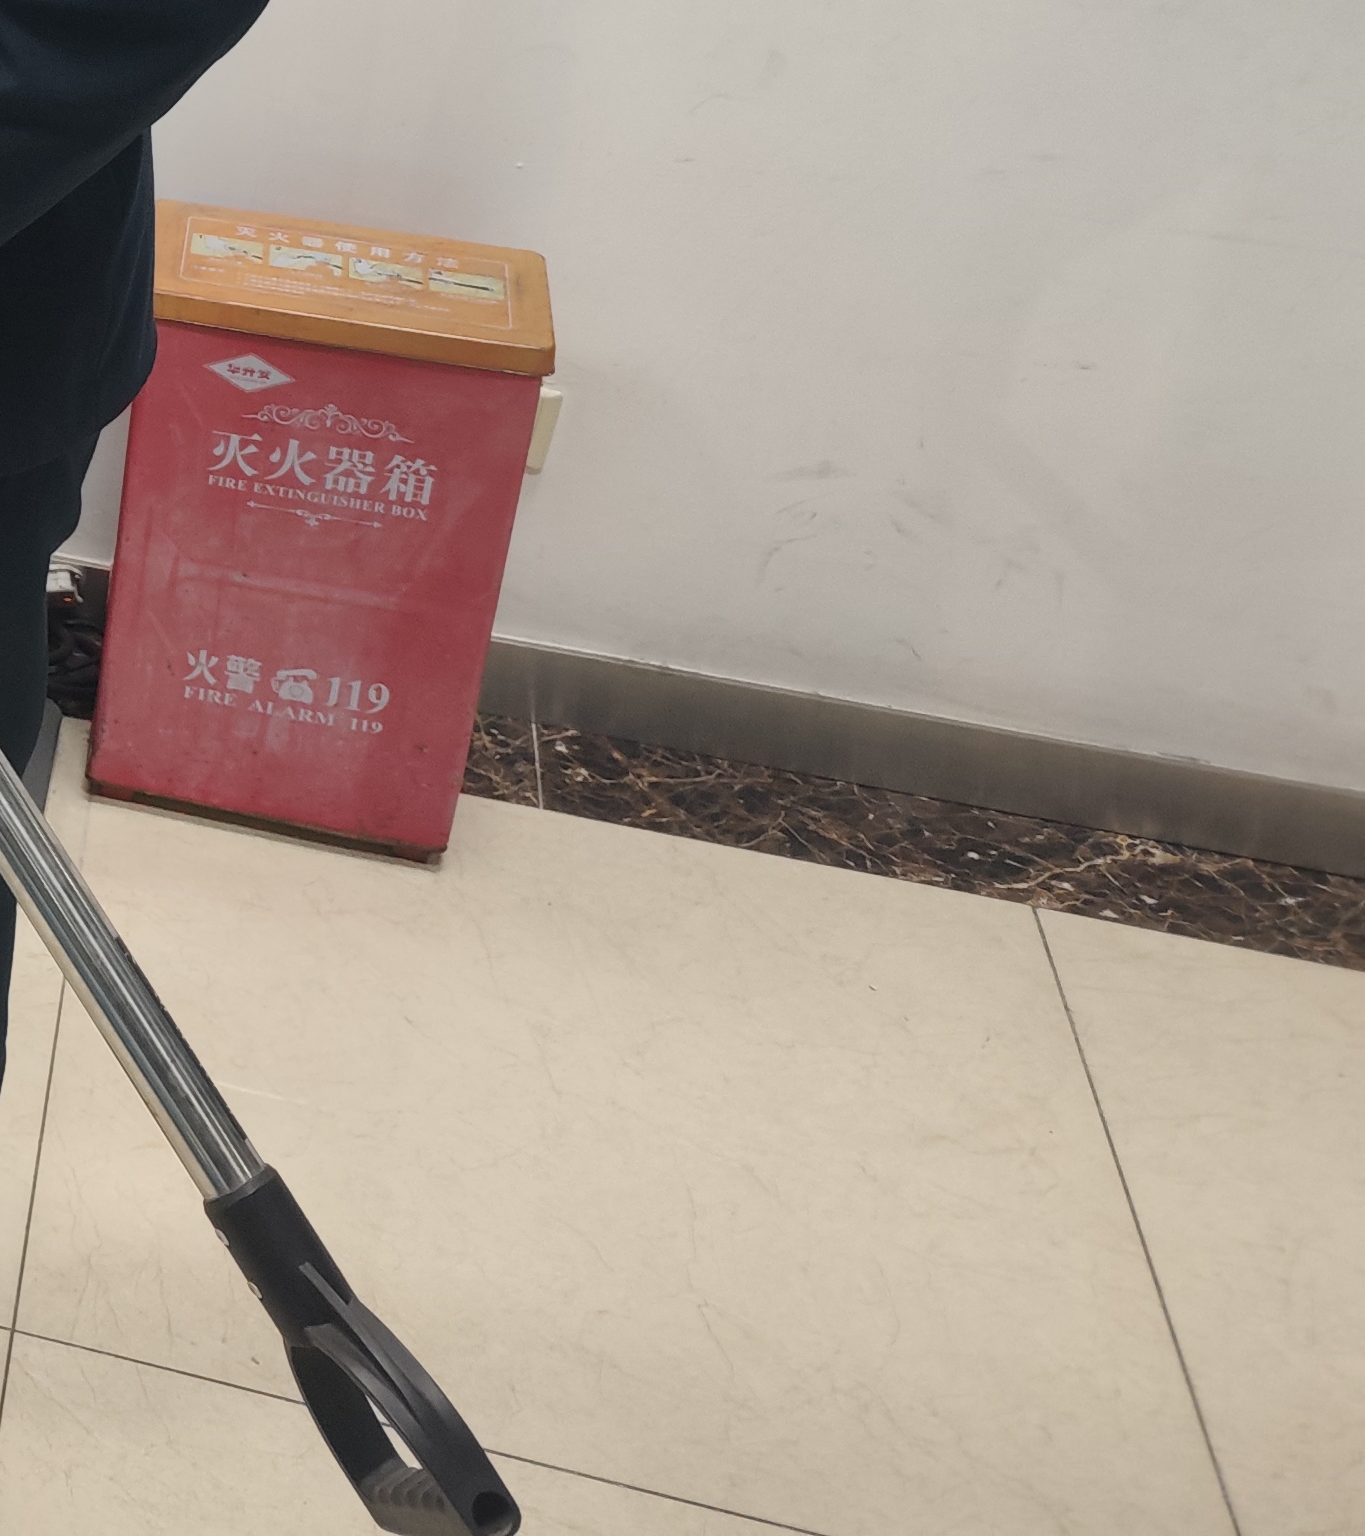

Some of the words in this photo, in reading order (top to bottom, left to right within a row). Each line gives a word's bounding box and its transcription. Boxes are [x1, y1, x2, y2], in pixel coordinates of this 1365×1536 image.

[207, 430, 437, 505] 灭火器箱
[208, 474, 247, 491] FIRE
[254, 483, 385, 514] EXTINGUISHER
[392, 502, 428, 521] BOX
[183, 650, 262, 694] 火警
[325, 677, 390, 714] 119
[183, 685, 237, 707] FIRE
[248, 699, 335, 727] ALARM
[351, 718, 384, 735] 119
